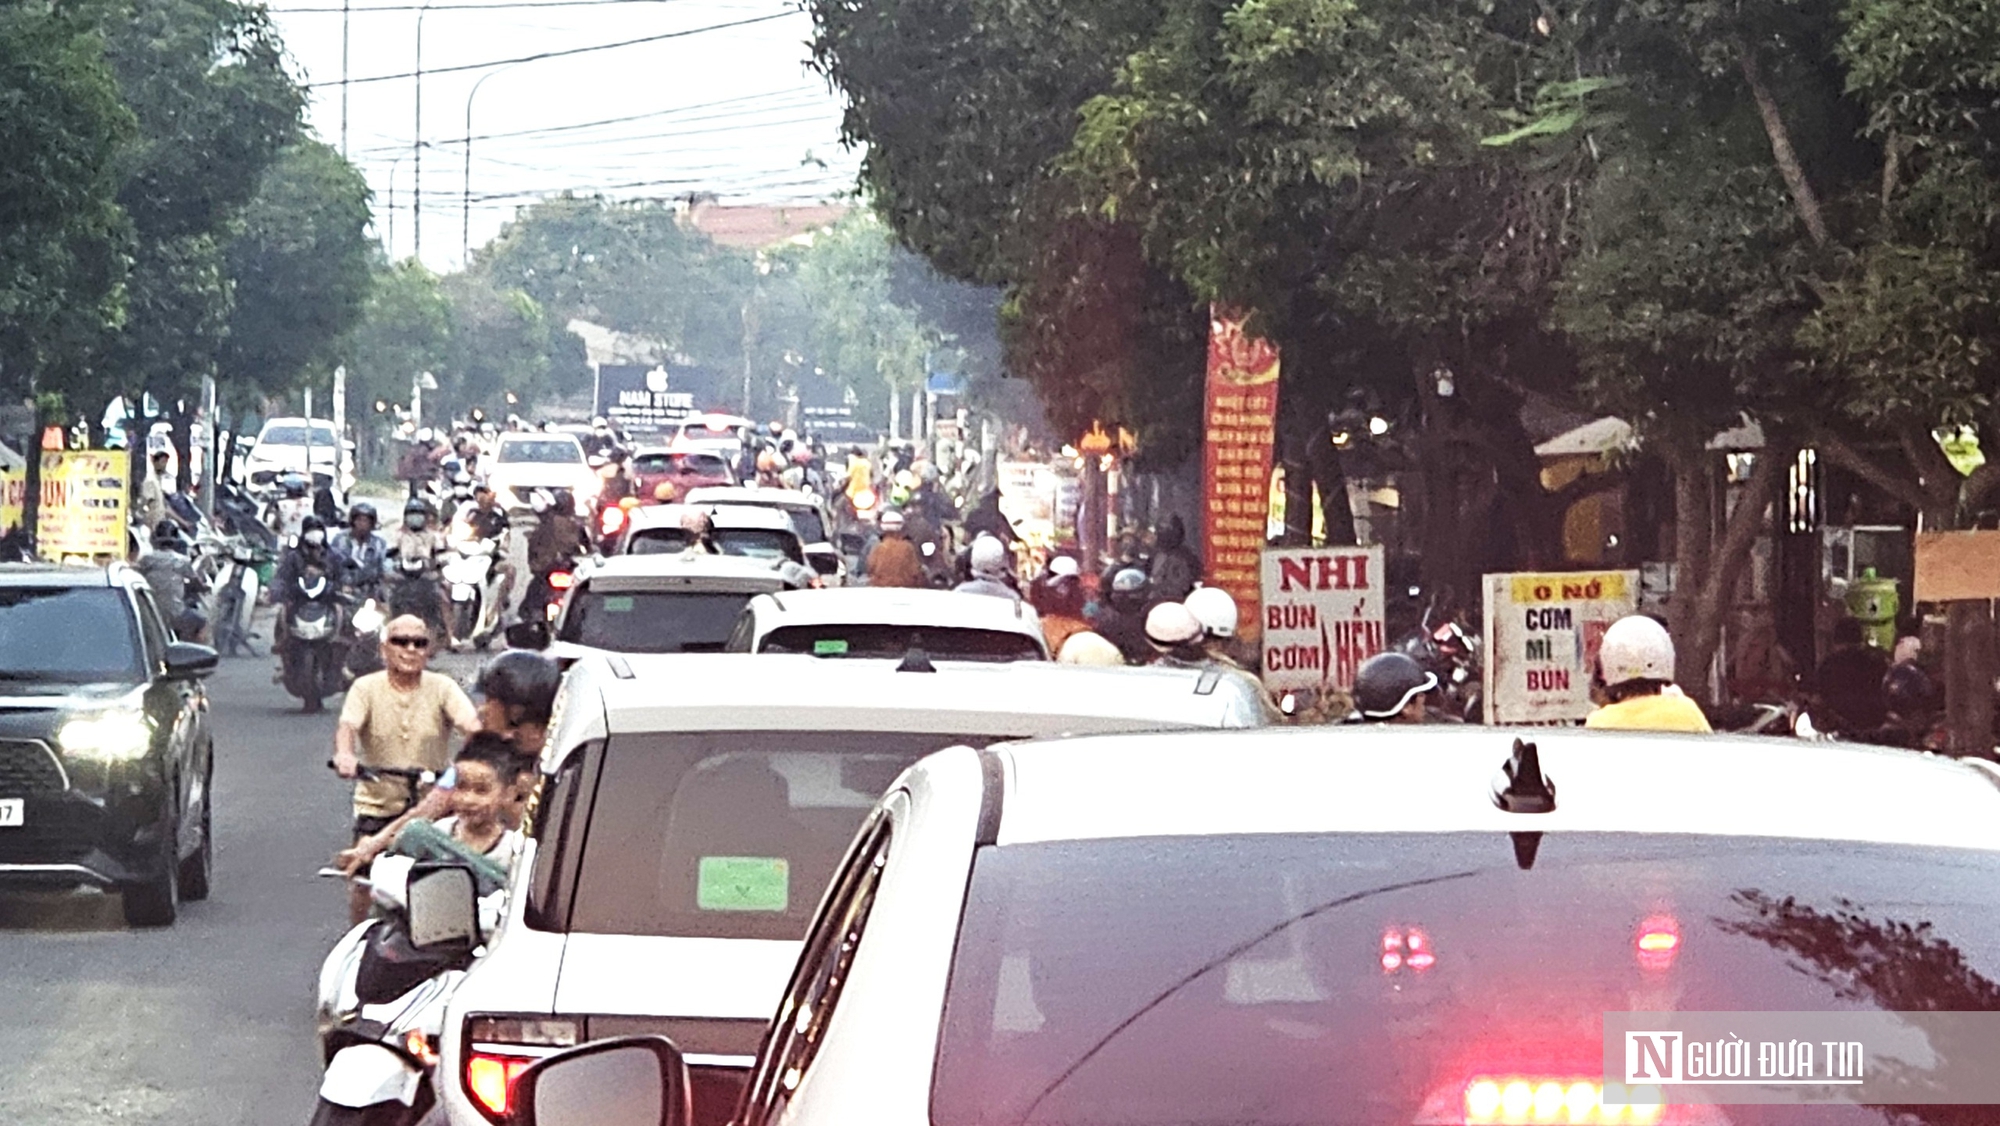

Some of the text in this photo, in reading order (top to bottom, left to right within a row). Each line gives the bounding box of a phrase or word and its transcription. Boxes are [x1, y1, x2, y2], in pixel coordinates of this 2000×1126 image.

[1278, 555, 1369, 592] NHI
[1267, 600, 1316, 630] BÚN
[1526, 607, 1572, 631] CƠM
[1267, 643, 1319, 671] CƠM
[1527, 666, 1569, 691] BÚN
